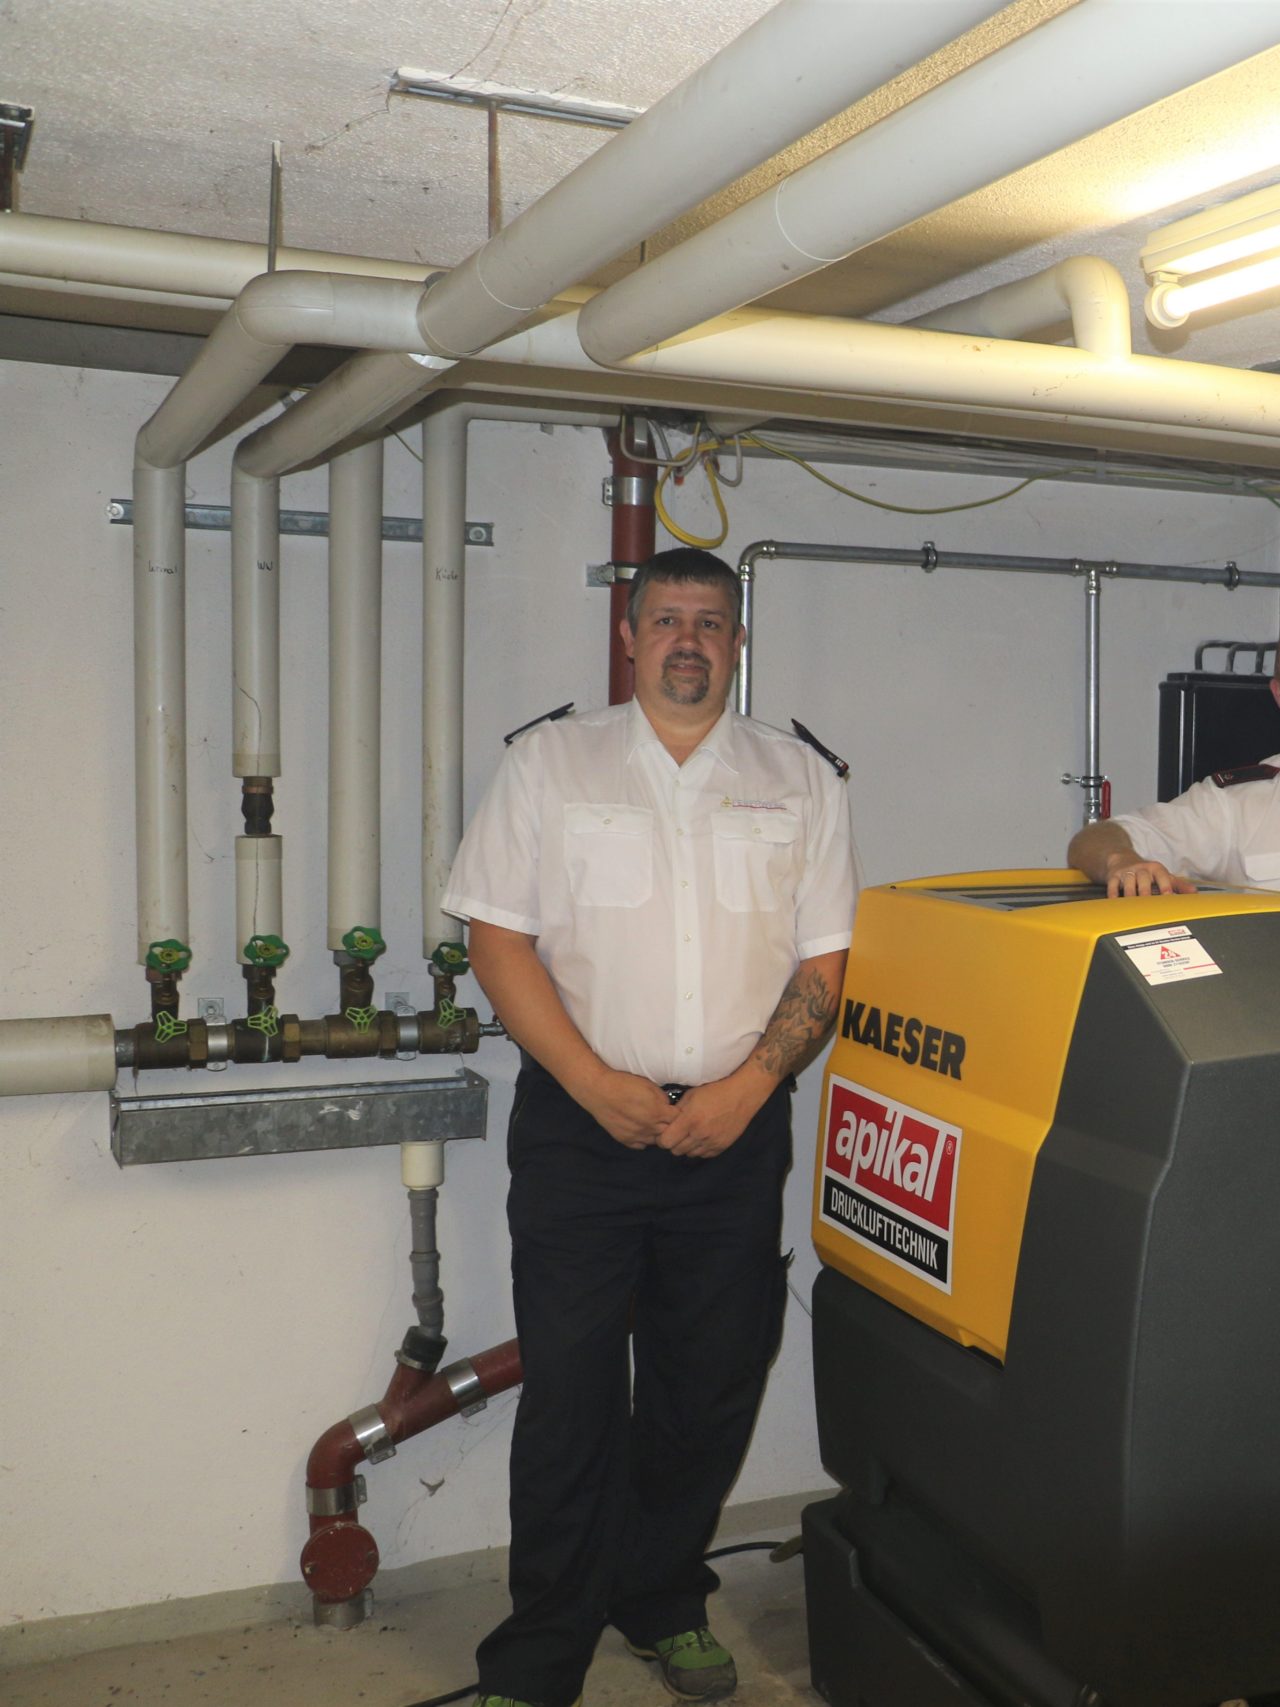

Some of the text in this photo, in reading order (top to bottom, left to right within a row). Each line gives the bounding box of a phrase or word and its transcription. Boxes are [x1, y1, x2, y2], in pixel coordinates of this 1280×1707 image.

[841, 998, 967, 1081] KAESER
[834, 1105, 945, 1203] apikal
[830, 1186, 939, 1271] DRUCKLUFTTECHNIK
